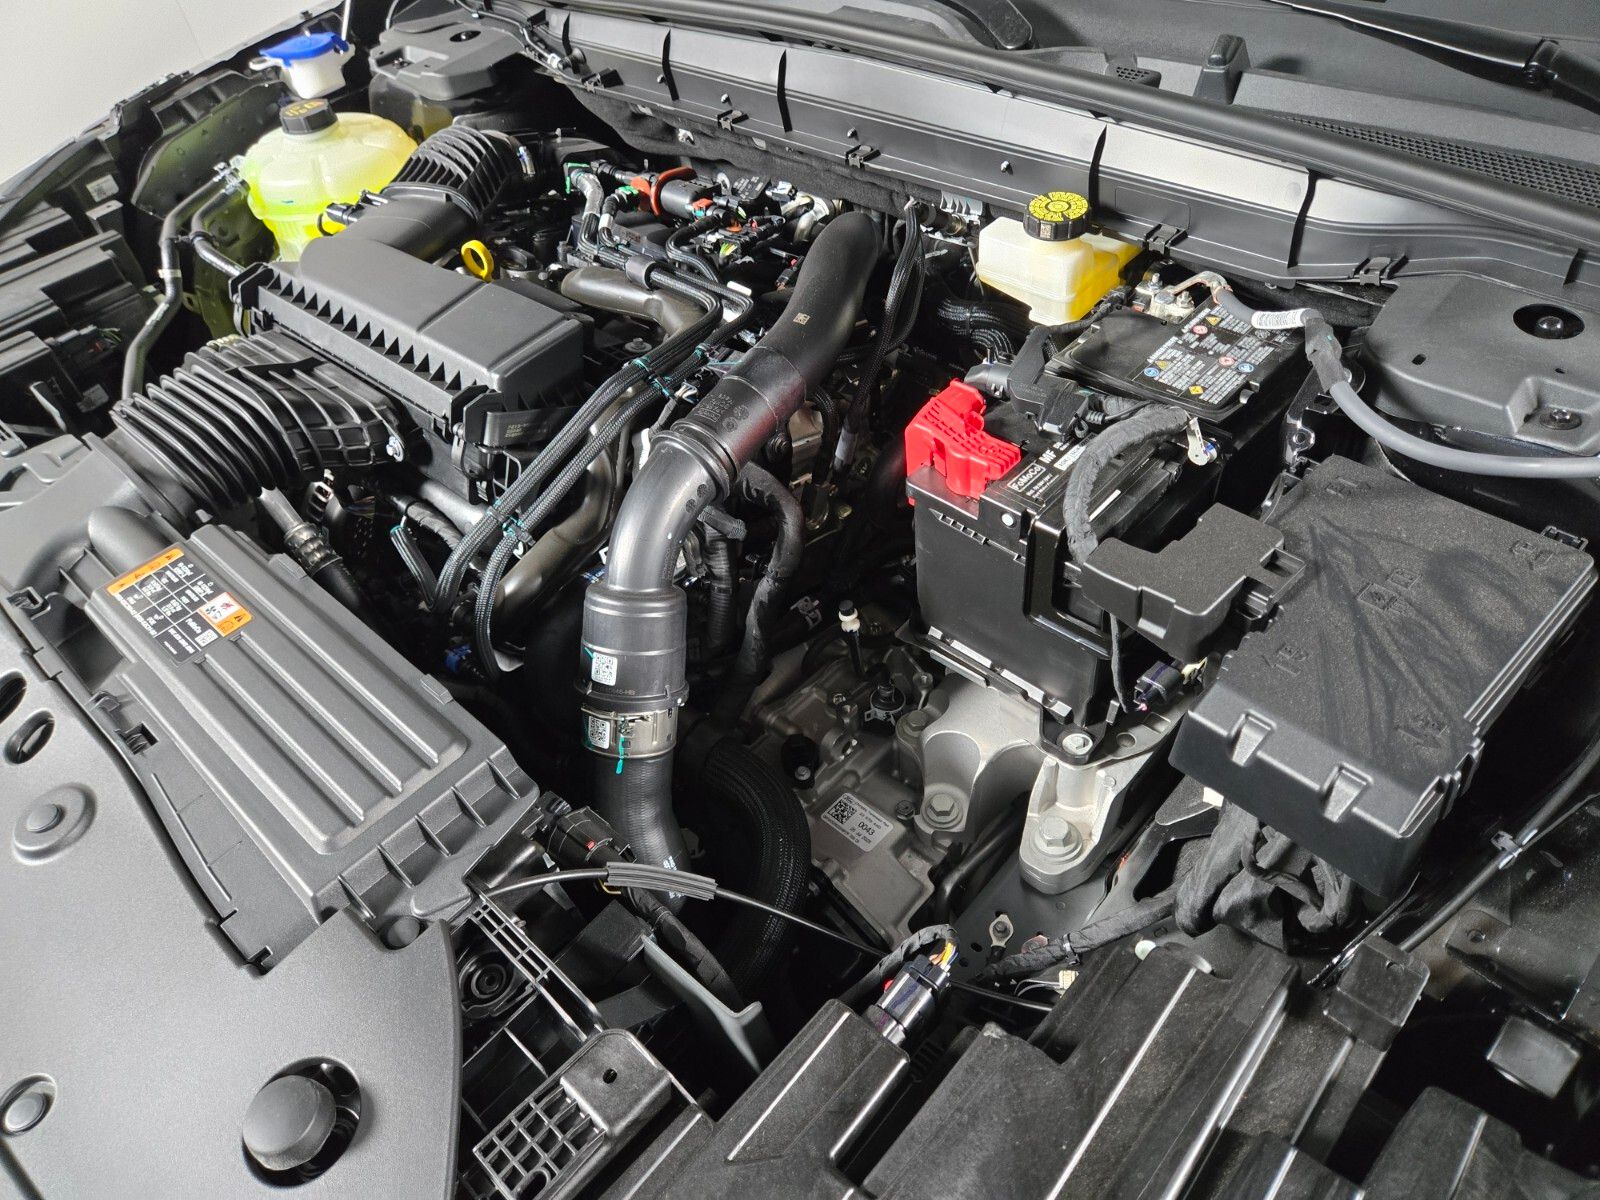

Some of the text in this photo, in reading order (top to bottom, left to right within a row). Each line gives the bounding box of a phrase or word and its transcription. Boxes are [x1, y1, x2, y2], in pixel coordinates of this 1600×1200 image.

[1011, 466, 1042, 491] FoMoCo
[1039, 449, 1057, 464] MF
[858, 821, 876, 836] 0043
